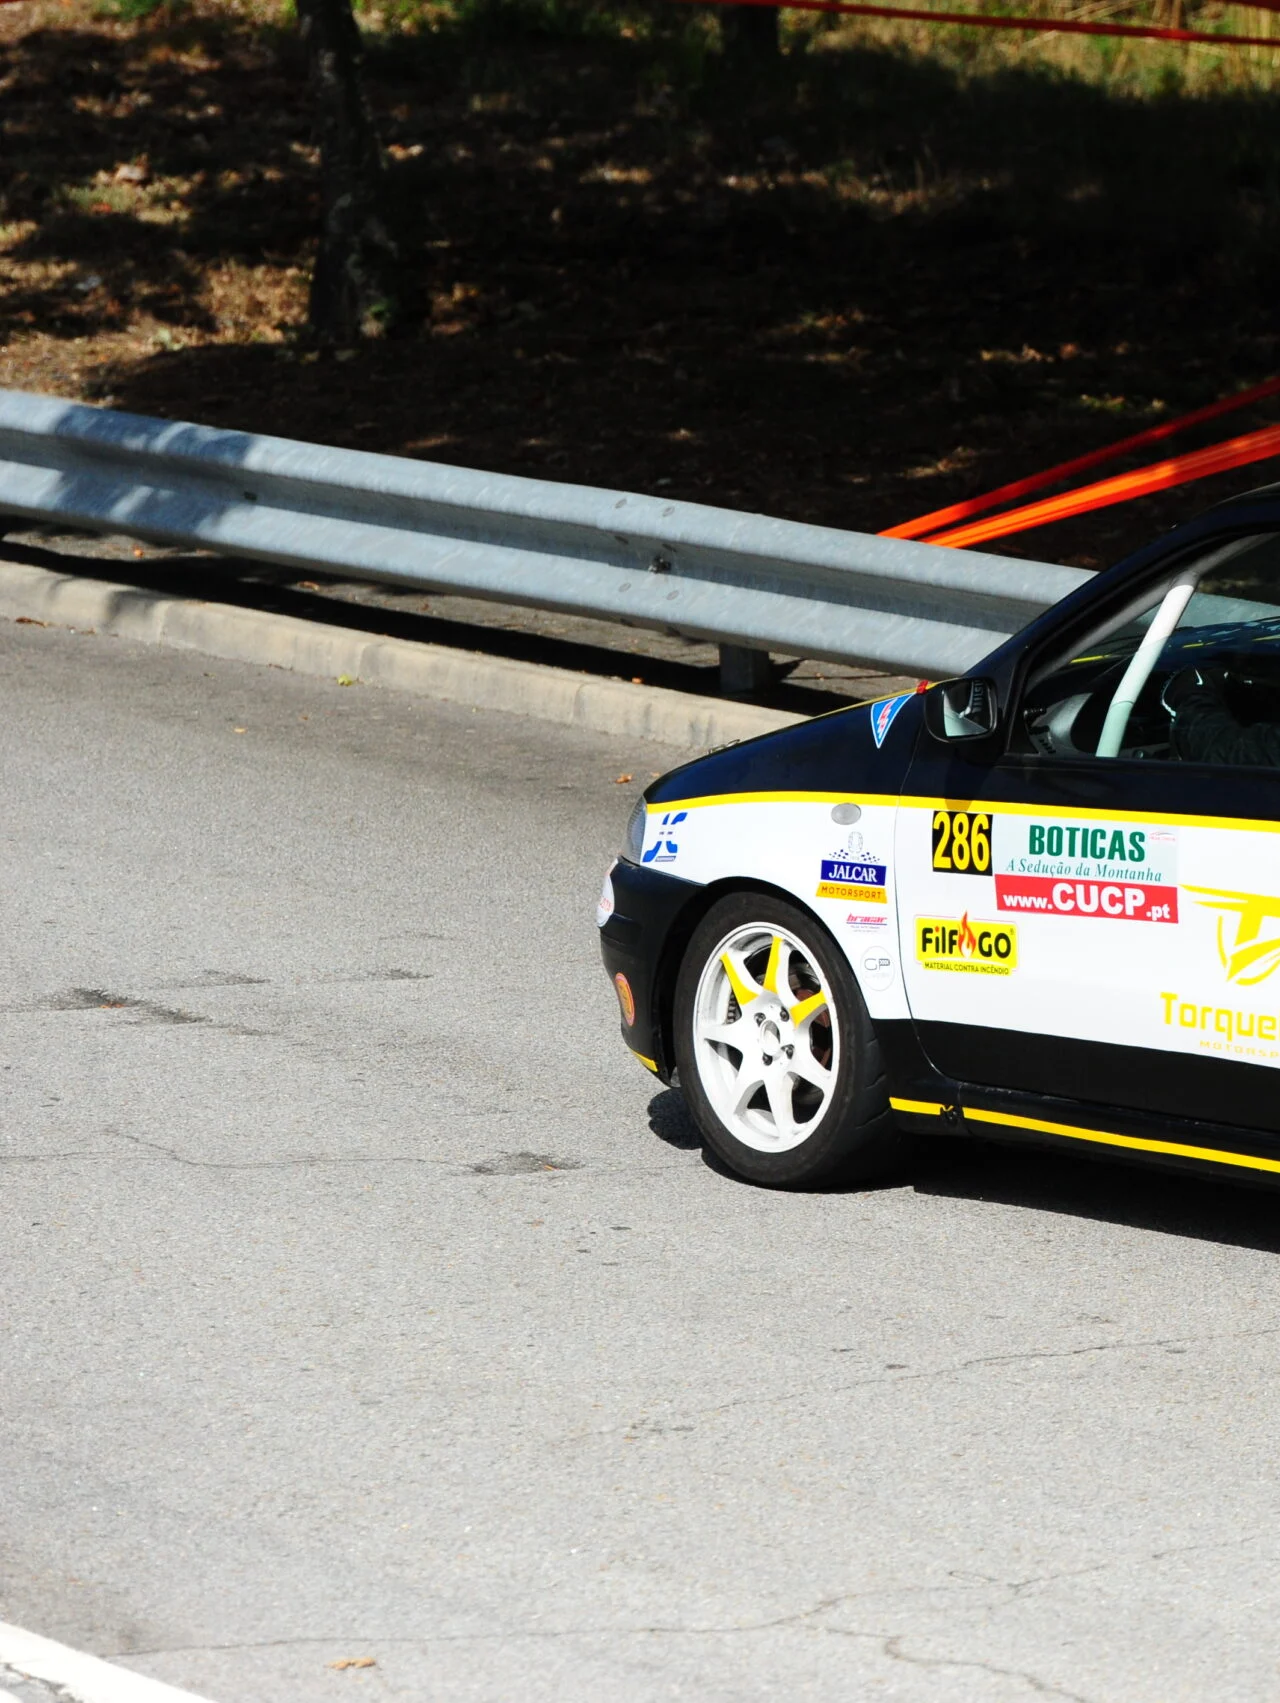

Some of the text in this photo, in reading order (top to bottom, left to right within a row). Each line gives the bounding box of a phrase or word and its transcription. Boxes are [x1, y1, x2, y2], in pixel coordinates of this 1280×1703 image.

[932, 811, 990, 872] 286
[1029, 824, 1146, 862] BOTICAS
[829, 864, 878, 883] JALCAR
[1006, 858, 1162, 882] A Sedução da Montanha
[821, 885, 882, 899] MOTORSPORT
[1003, 882, 1171, 921] www.CUCP.pt
[925, 961, 953, 971] MATERIAL
[954, 964, 979, 973] CONTRA
